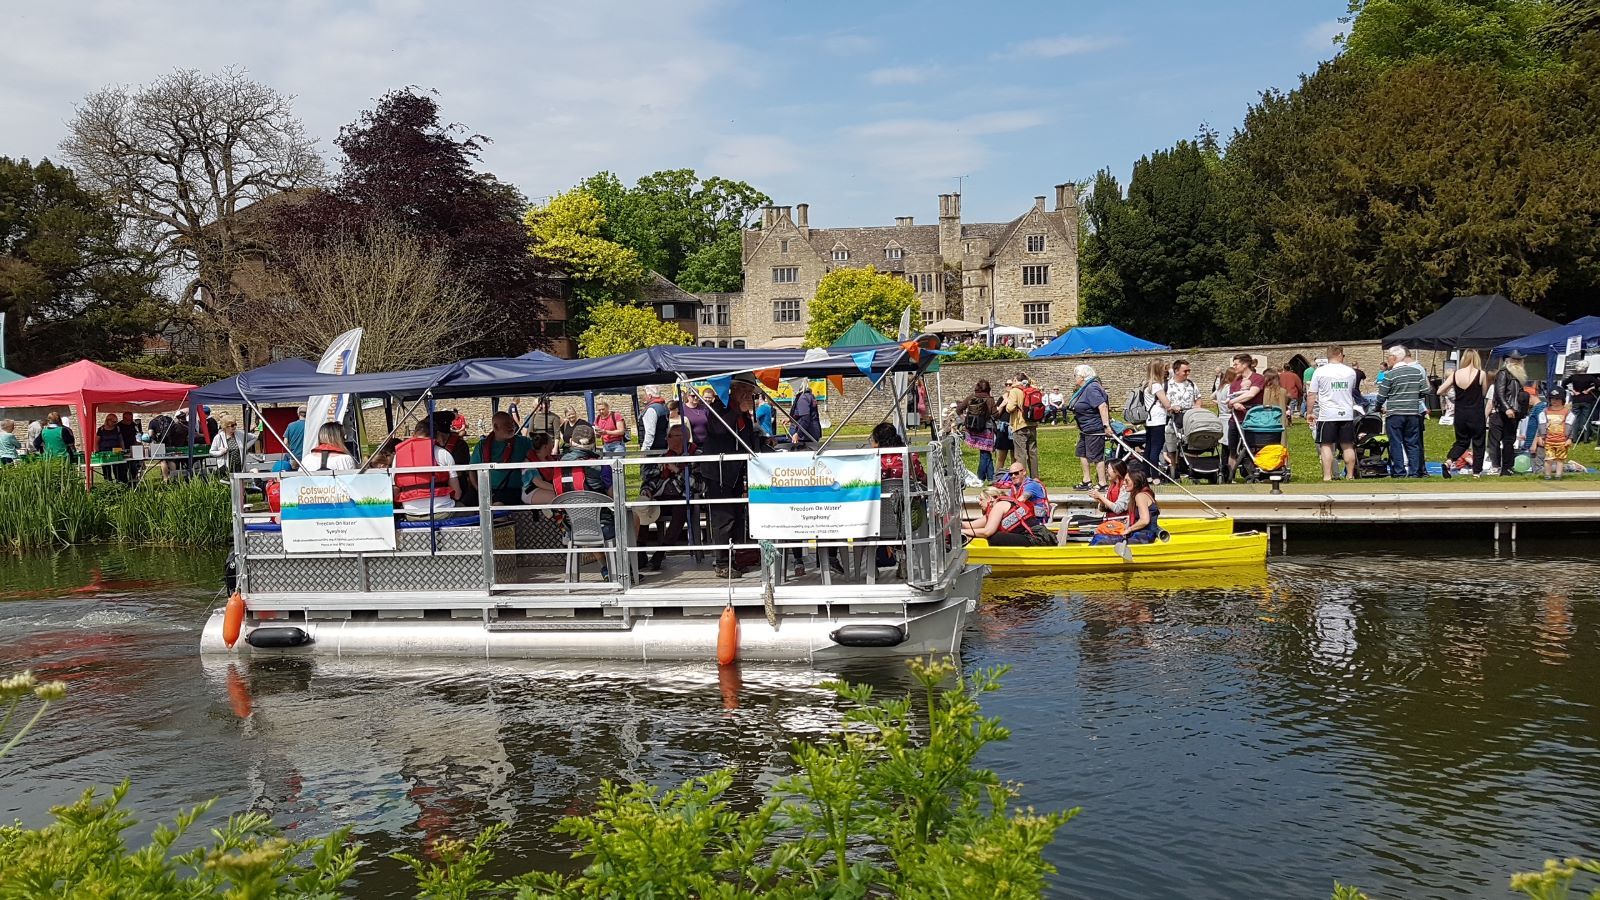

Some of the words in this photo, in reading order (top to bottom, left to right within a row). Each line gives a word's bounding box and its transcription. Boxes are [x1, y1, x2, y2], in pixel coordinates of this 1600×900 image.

[1331, 381, 1349, 389] MINCH
[774, 466, 816, 477] Cotswold
[771, 476, 835, 487] Boatmobility
[301, 486, 336, 495] Cotswold
[298, 493, 350, 504] Boatmobility
